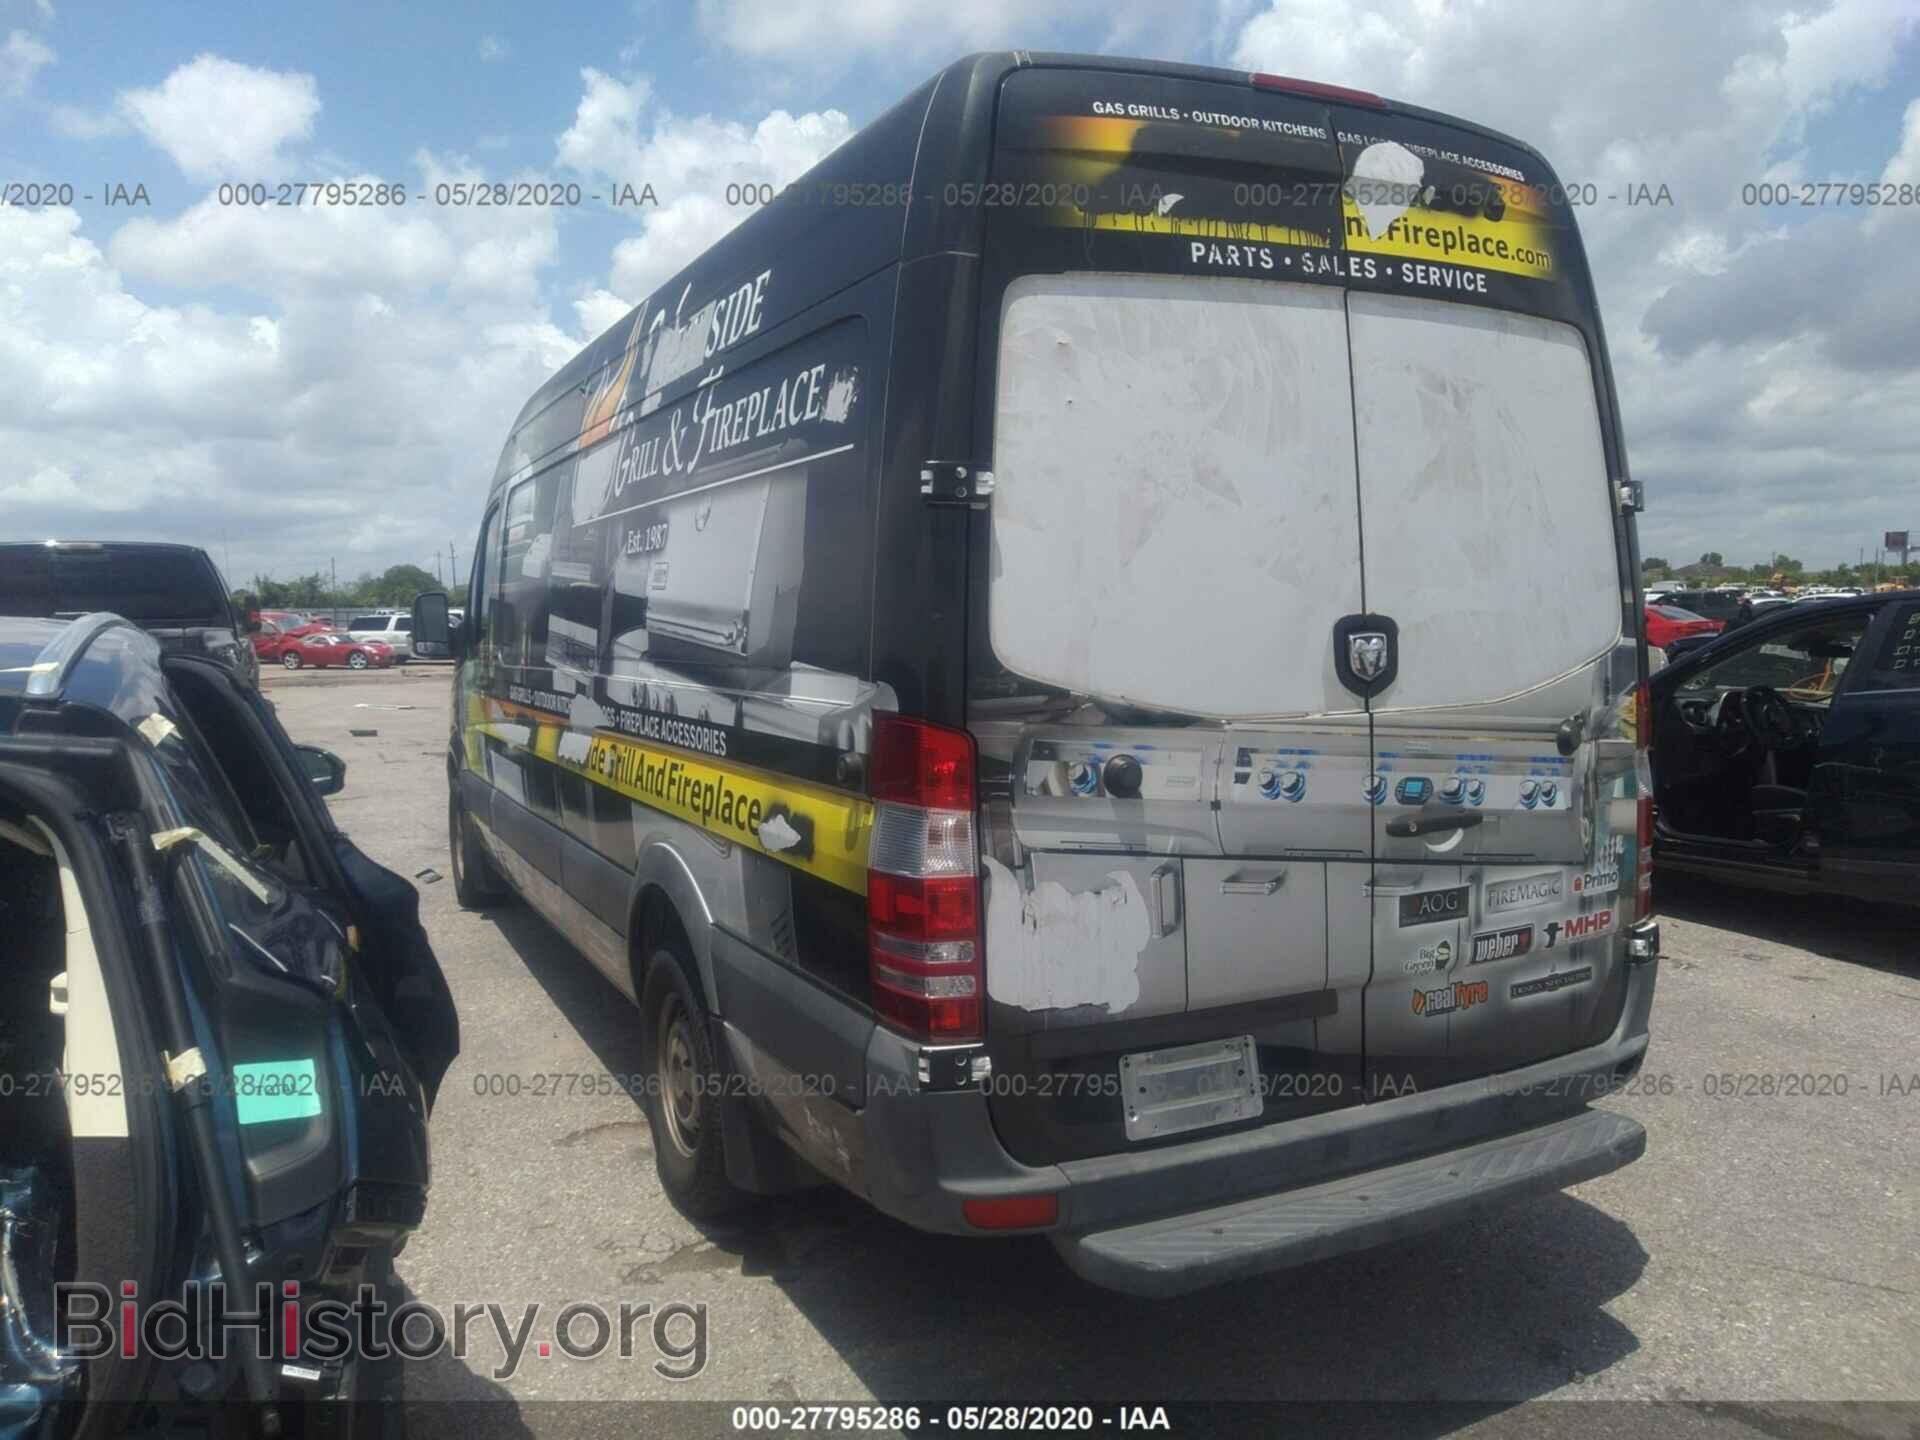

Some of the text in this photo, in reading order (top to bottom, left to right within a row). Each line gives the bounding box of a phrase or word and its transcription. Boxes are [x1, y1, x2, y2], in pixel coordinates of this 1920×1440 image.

[1092, 101, 1328, 140] GAS GRILLS OUTDOOR KITCHENS
[1337, 131, 1363, 145] GAS
[1402, 143, 1462, 165] IREPLACE
[1462, 155, 1525, 182] ACCESSORIES
[1190, 241, 1488, 294] PARTS SALES SERVICE
[662, 407, 688, 476] &
[687, 363, 826, 475] FIREPLACE
[627, 523, 668, 554] Est. 1987
[618, 708, 660, 738] FIREPLACE
[660, 717, 728, 758] ACCESSORIES
[1584, 870, 1618, 890] Primo
[1419, 890, 1457, 915] AOG
[1564, 910, 1612, 938] MHP
[1475, 933, 1519, 961] weber
